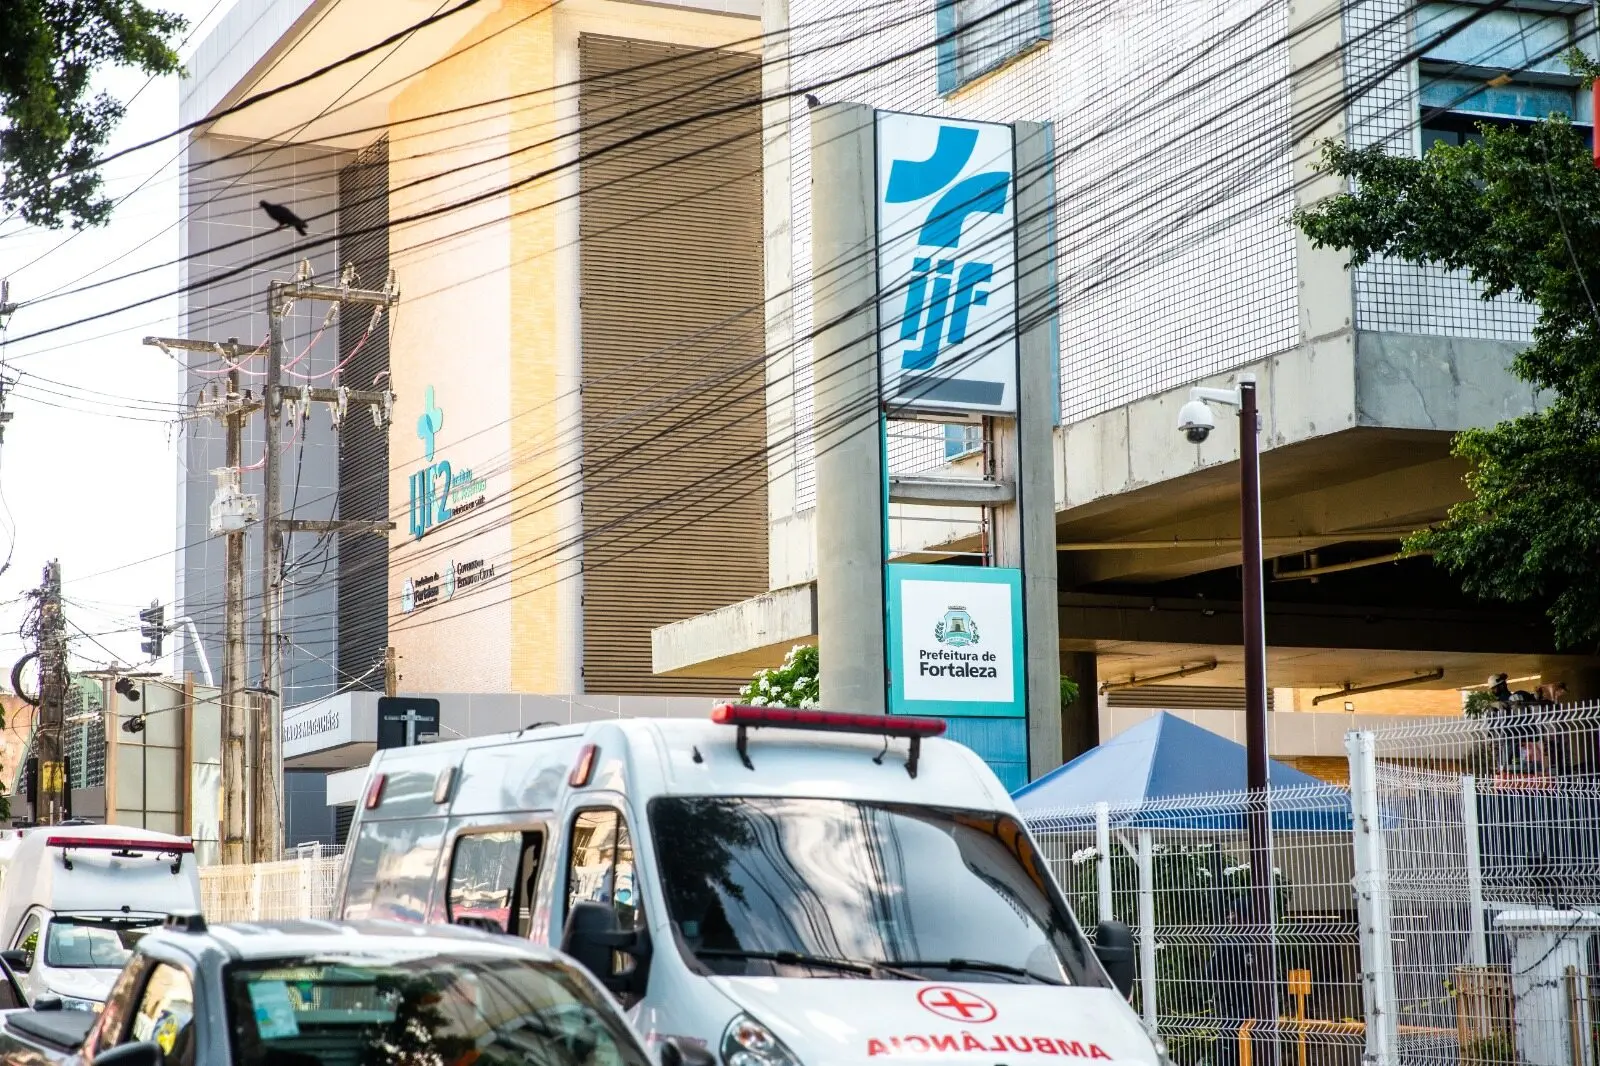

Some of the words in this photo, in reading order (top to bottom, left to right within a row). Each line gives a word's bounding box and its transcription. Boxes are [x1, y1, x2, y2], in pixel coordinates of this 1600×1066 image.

[919, 649, 979, 661] Prefeitura
[982, 651, 997, 662] de
[919, 661, 997, 678] Fortaleza
